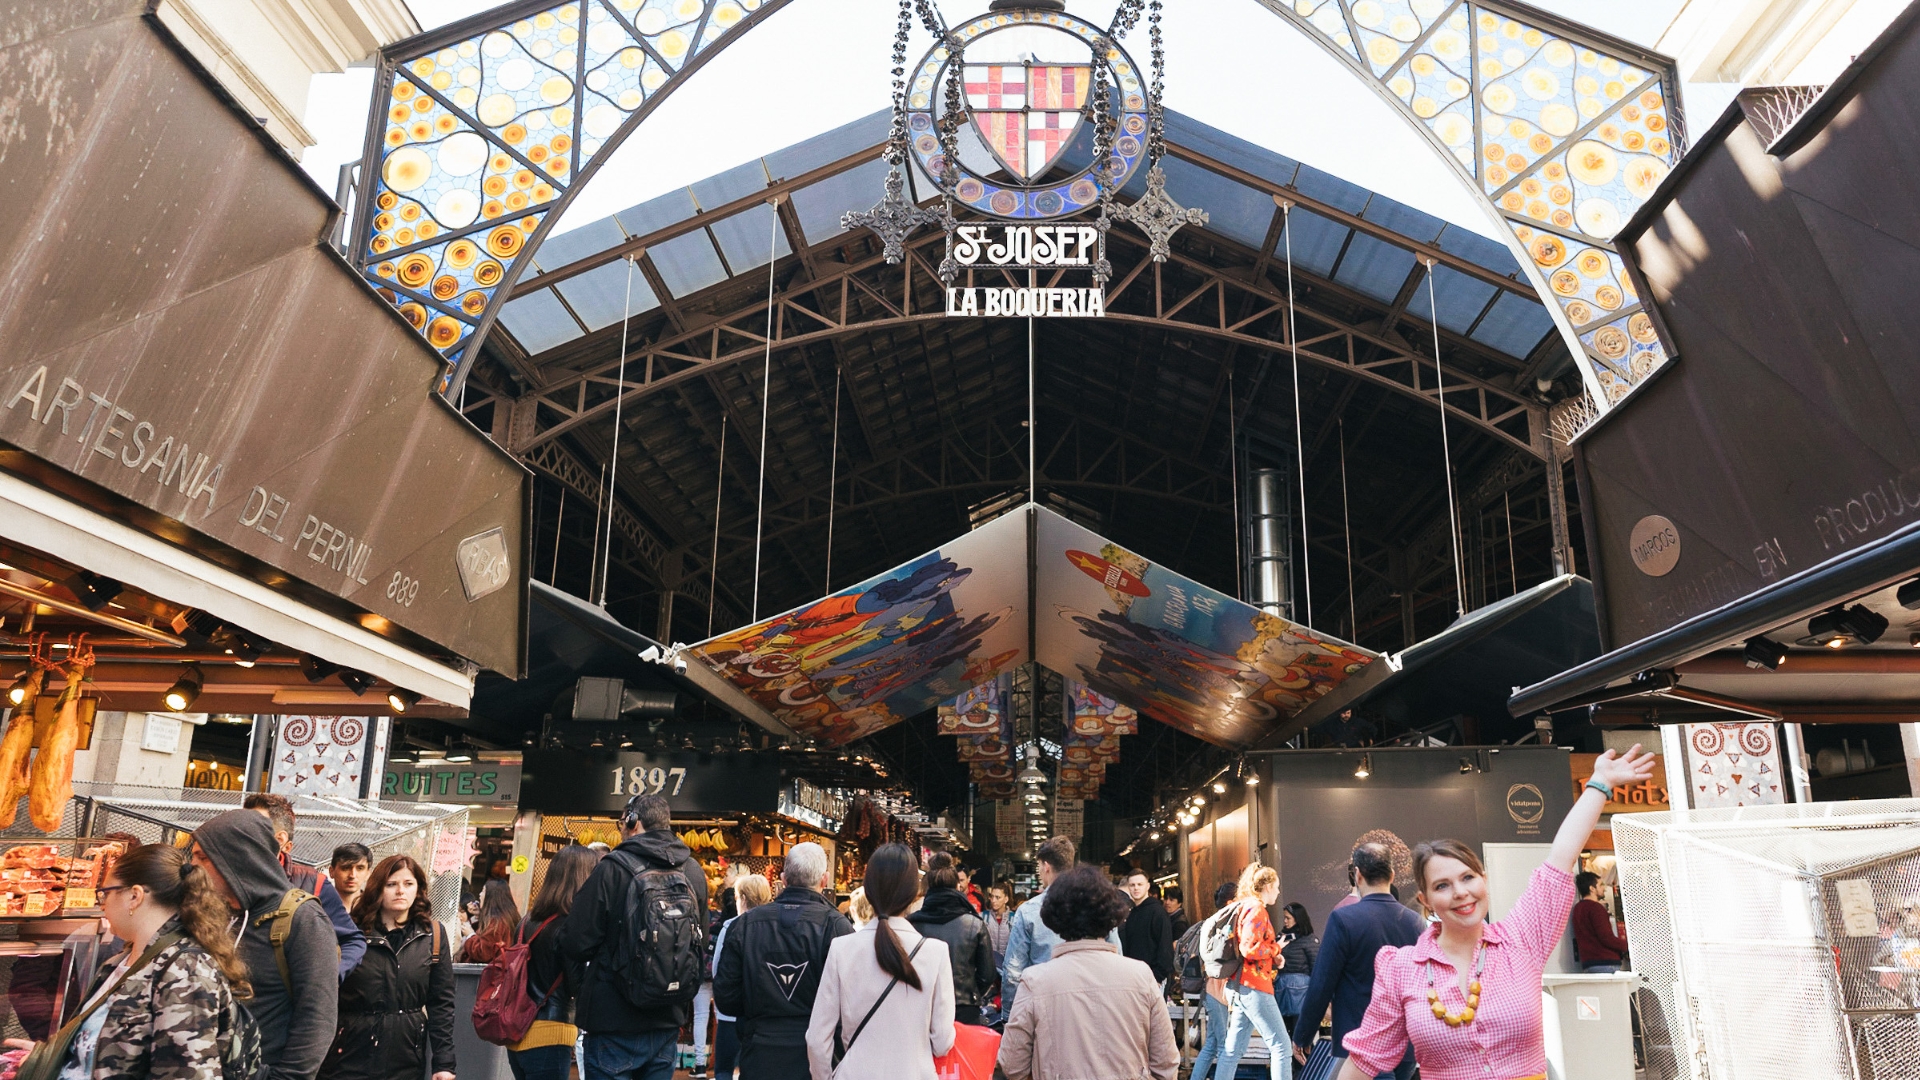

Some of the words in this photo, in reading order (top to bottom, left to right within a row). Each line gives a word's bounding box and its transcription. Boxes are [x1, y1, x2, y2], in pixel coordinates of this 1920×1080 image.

[987, 226, 1098, 265] JOSEP
[948, 288, 978, 316] LA
[985, 288, 1105, 316] BOQUERIA
[7, 365, 224, 508] ARTESANIA
[238, 485, 290, 544] DEL
[293, 513, 375, 586] PERNIL
[386, 570, 420, 608] 889
[464, 541, 505, 585] RIBAS
[1634, 527, 1675, 564] MARCOS
[1753, 537, 1787, 578] EN
[610, 766, 687, 796] 1897
